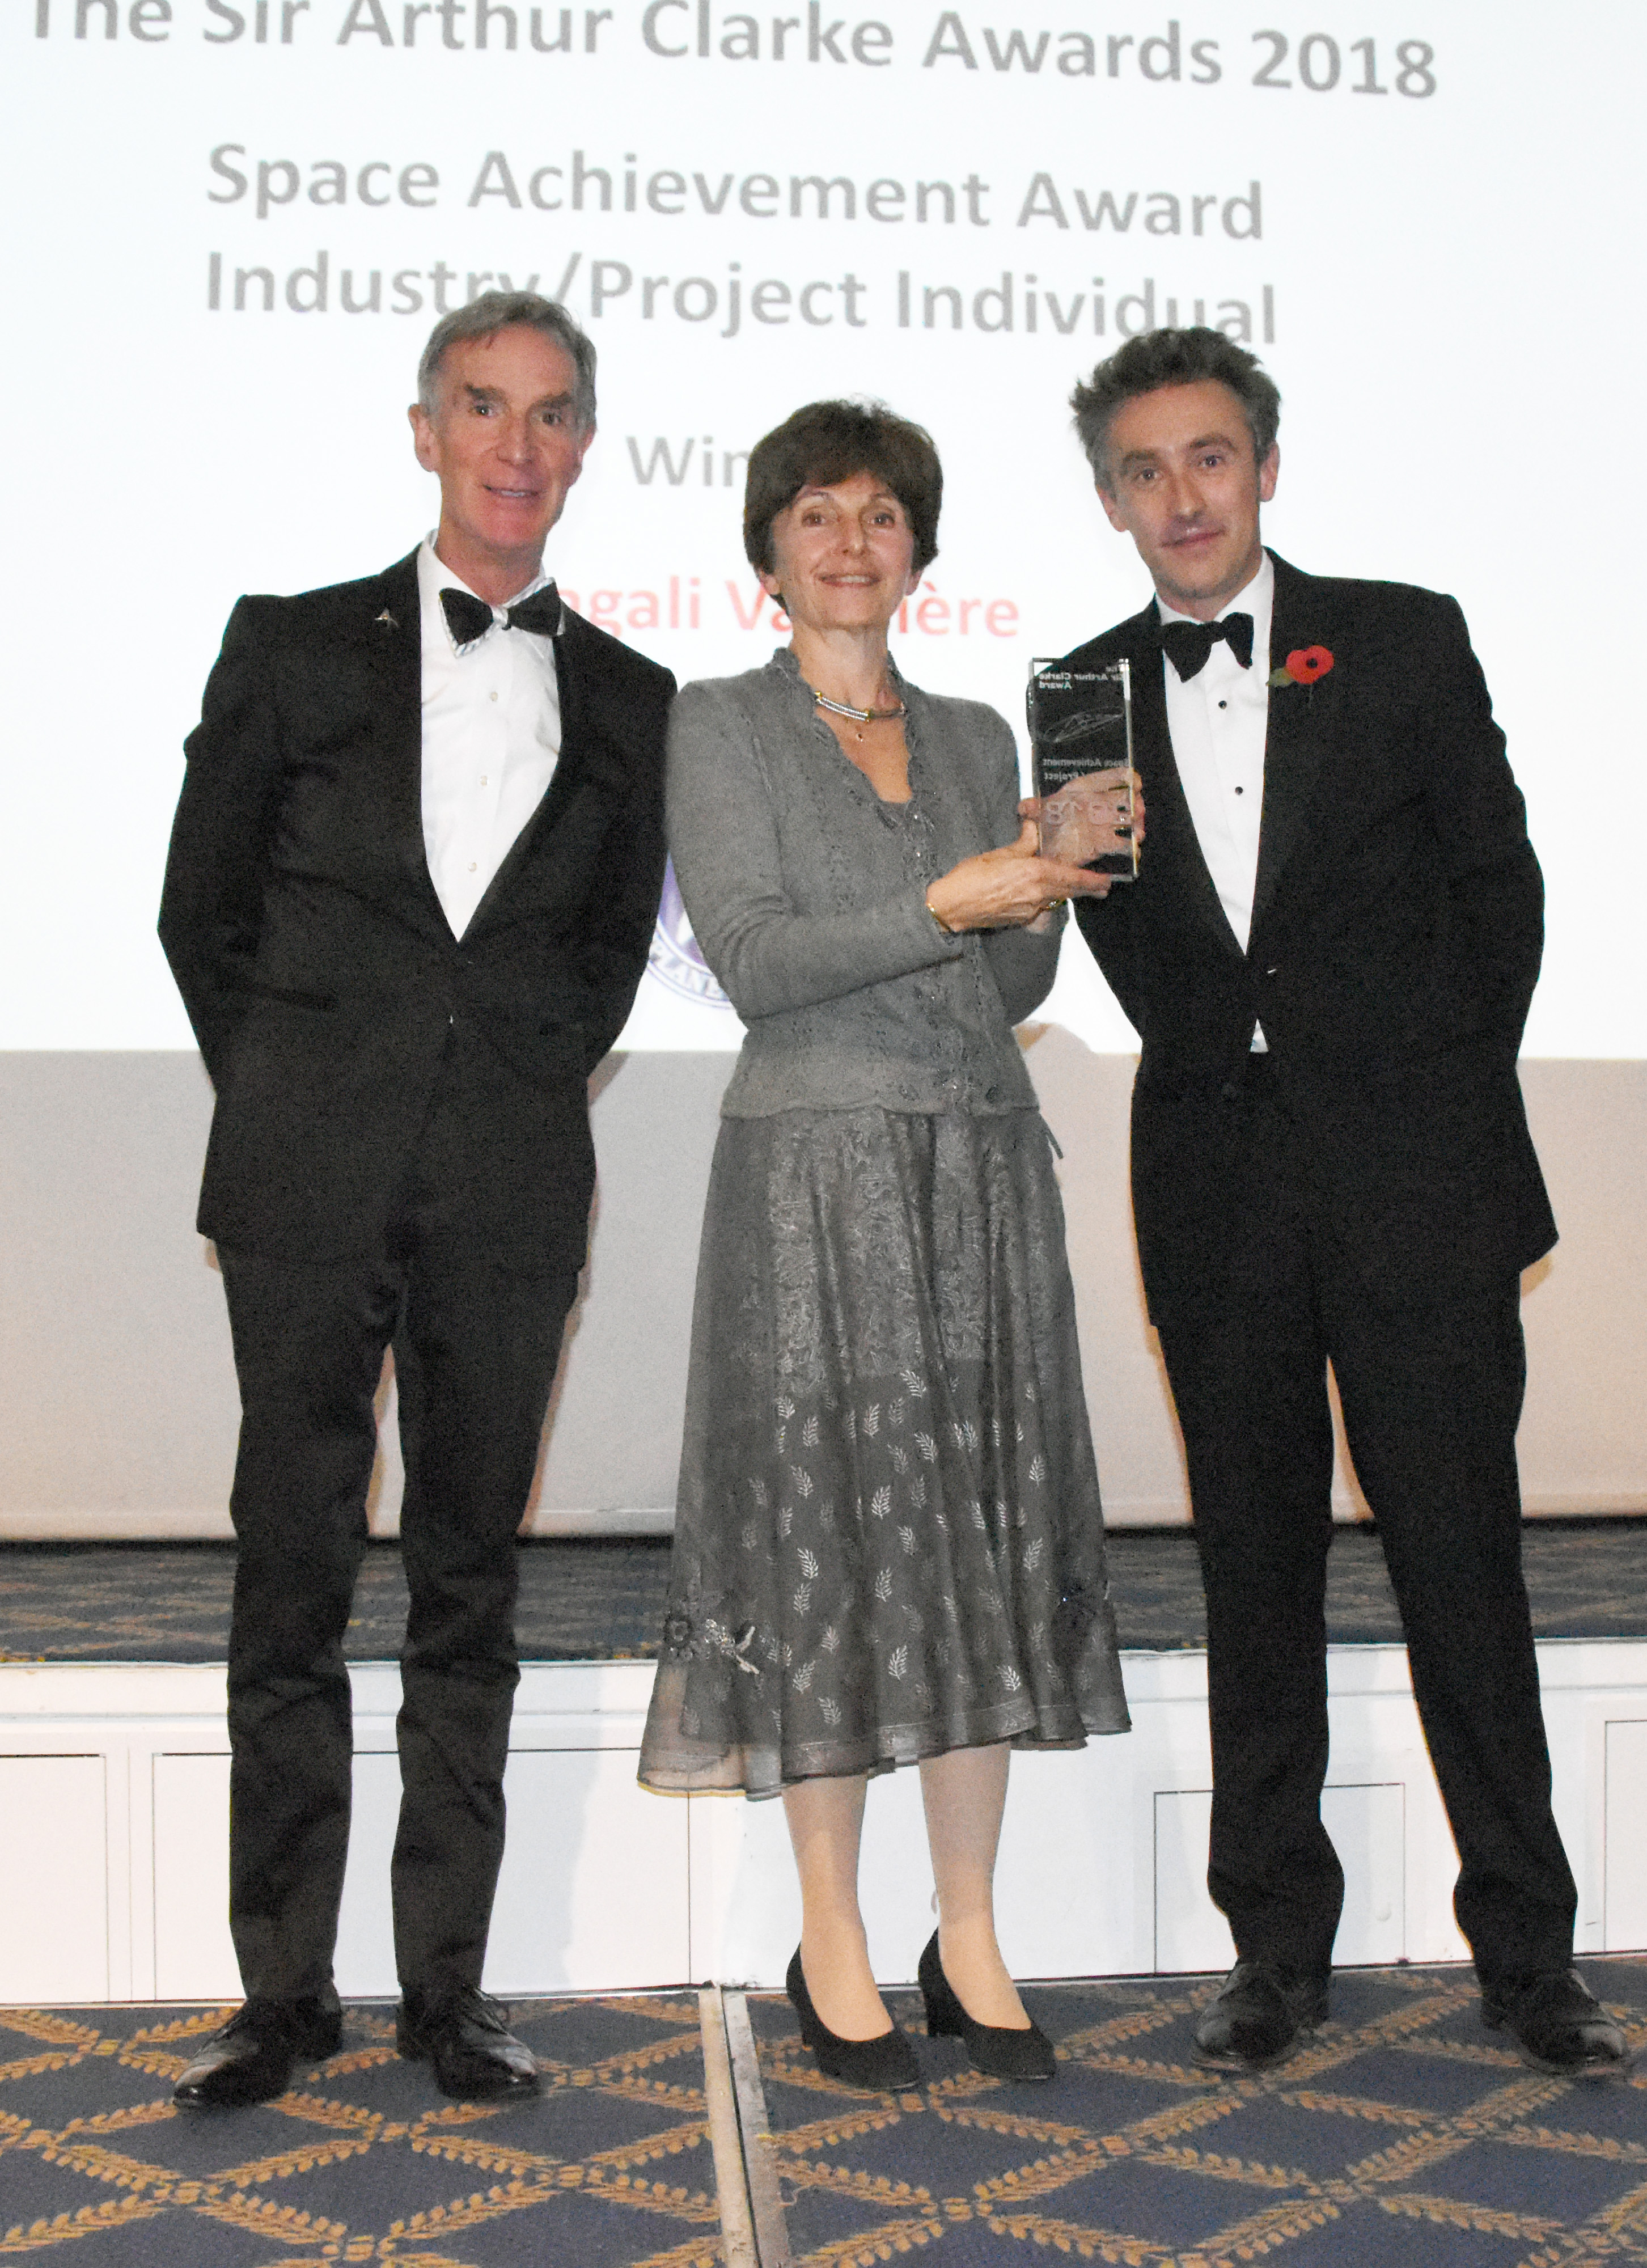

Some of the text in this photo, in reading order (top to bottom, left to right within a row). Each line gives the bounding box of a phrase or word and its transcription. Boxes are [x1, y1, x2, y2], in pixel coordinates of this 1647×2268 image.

[202, 0, 311, 45] Sir
[335, 0, 614, 54] Arthur
[641, 0, 895, 67] Clarke
[921, 10, 1223, 86] Awards
[1251, 28, 1438, 100] 2018
[207, 142, 1263, 239] Space Achievement Award
[897, 269, 1276, 345] Individual
[625, 435, 751, 487] Win
